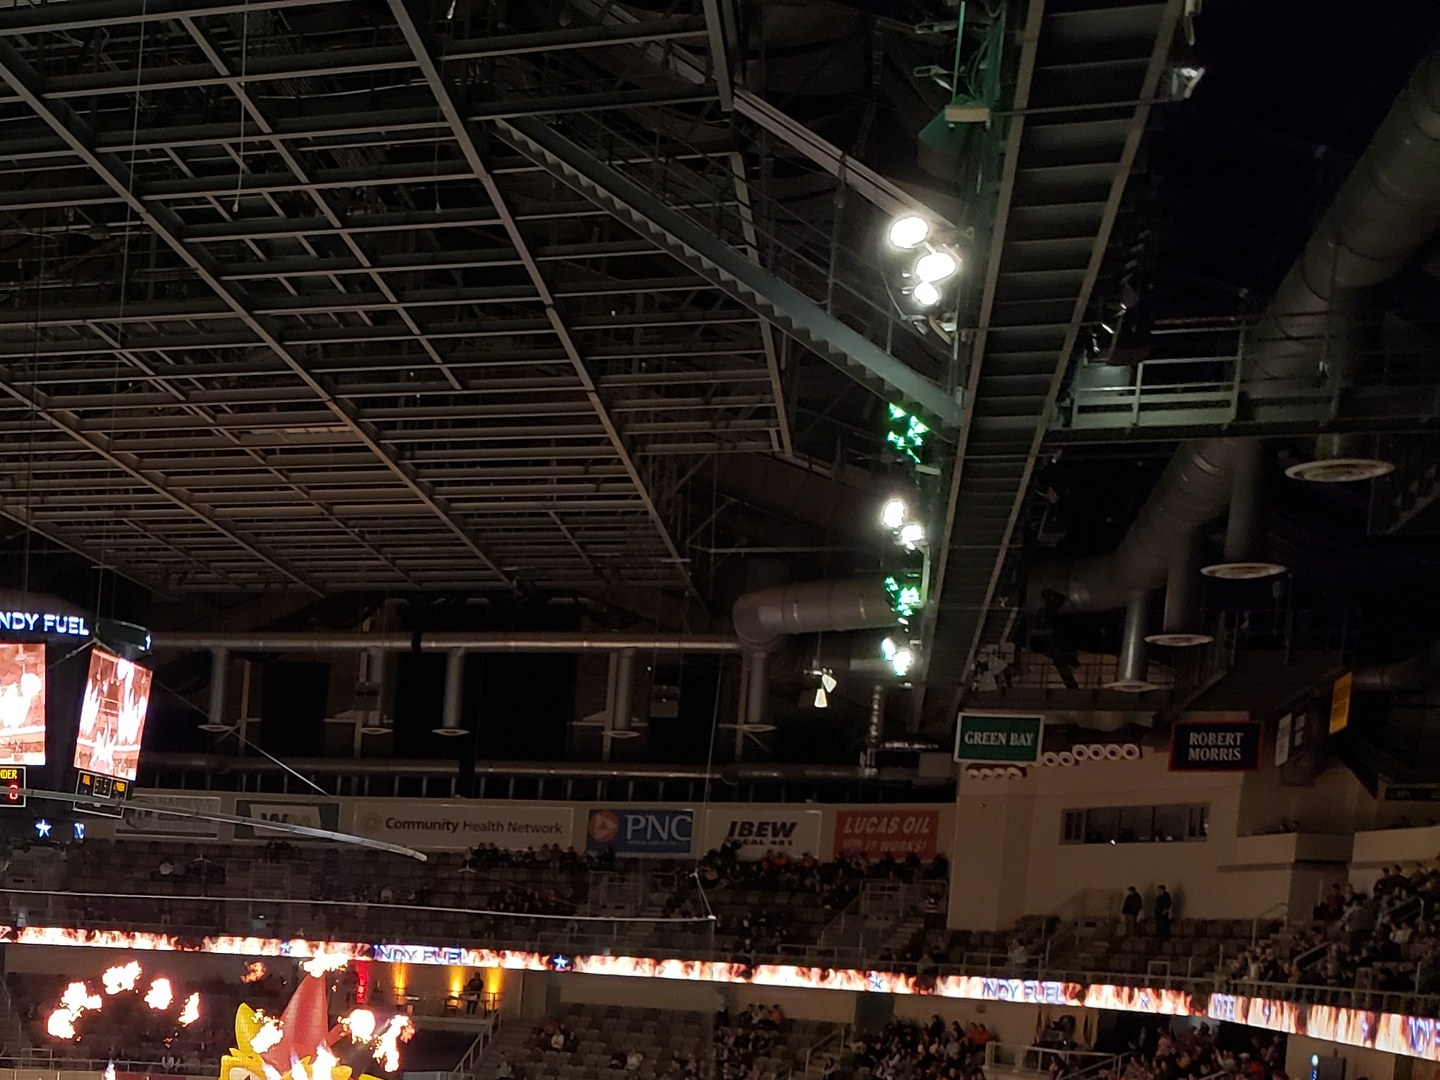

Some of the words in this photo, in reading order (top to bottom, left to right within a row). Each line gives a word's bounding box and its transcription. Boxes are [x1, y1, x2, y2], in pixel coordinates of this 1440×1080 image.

[44, 614, 89, 636] FUEL
[964, 730, 1007, 746] GREEN
[1010, 731, 1035, 747] BAY
[1189, 731, 1244, 748] ROBERT
[1188, 748, 1242, 762] MORRIS
[385, 817, 459, 834] Community
[463, 819, 504, 832] Health
[507, 821, 563, 834] Network
[625, 813, 693, 842] PNC
[727, 820, 798, 839] IBEW
[843, 816, 899, 834] LUCAS
[903, 816, 931, 834] OIL
[373, 944, 417, 961] INDY
[423, 947, 469, 965] FUEL
[983, 978, 1019, 1000] INDY
[1023, 980, 1064, 1004] FUEL
